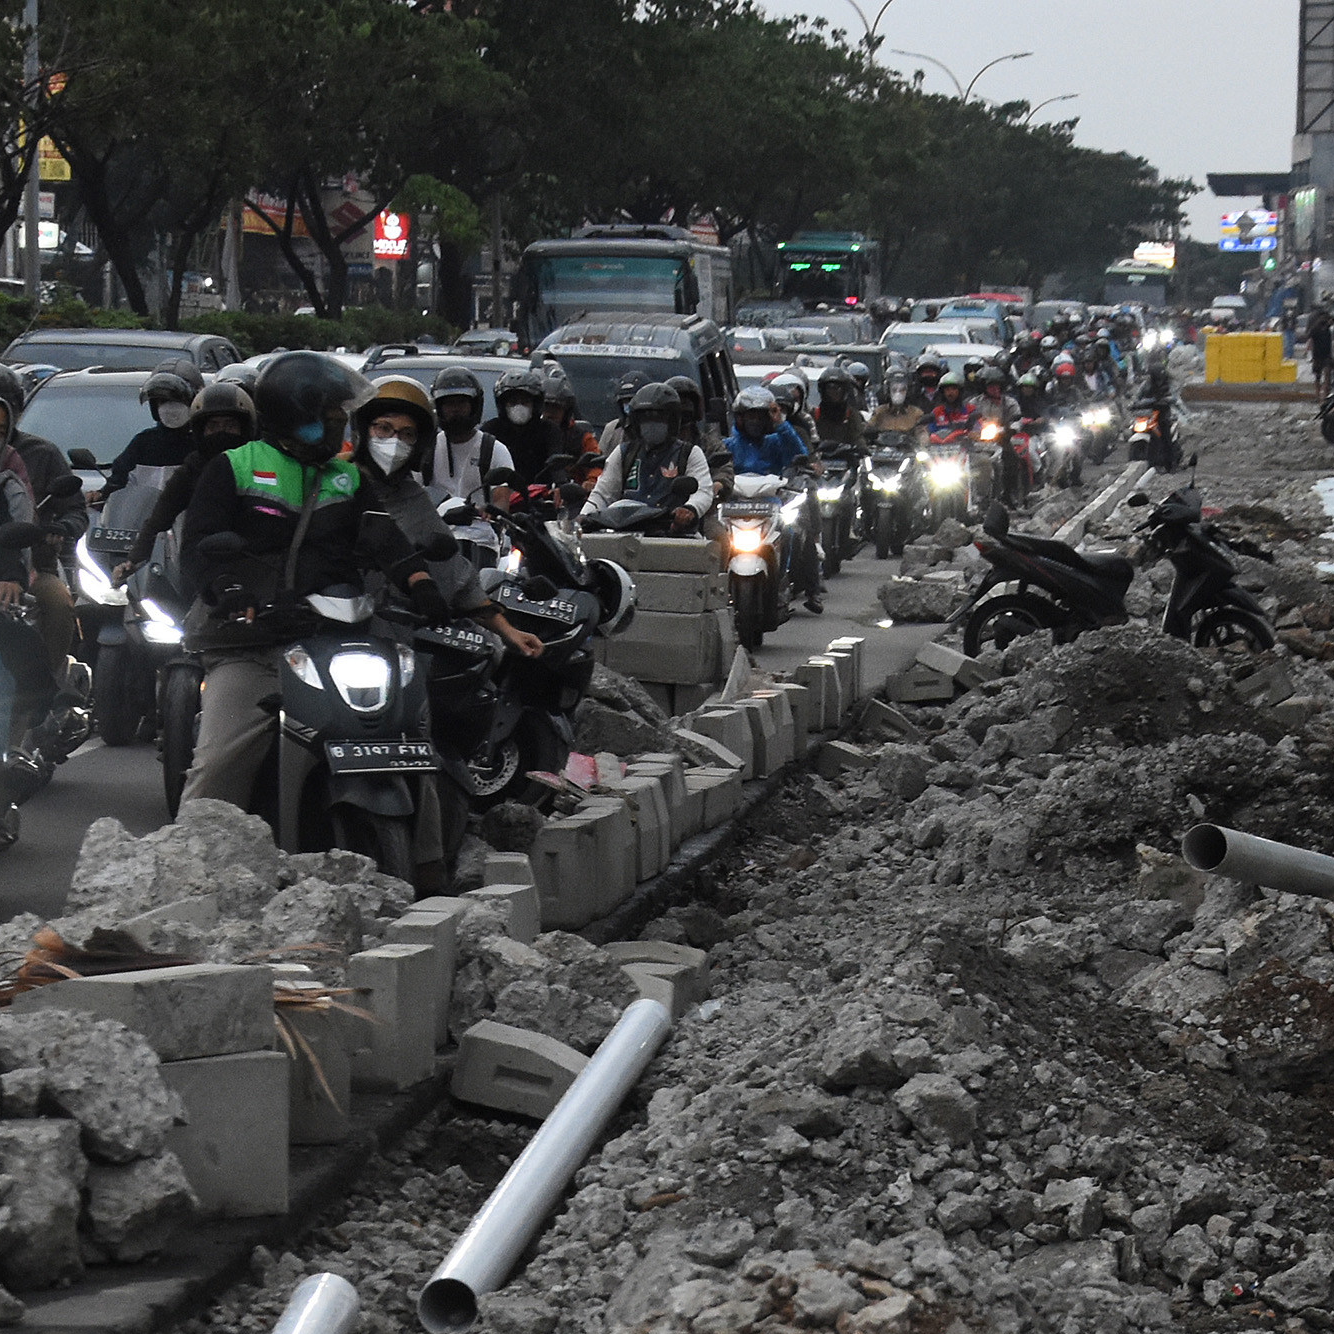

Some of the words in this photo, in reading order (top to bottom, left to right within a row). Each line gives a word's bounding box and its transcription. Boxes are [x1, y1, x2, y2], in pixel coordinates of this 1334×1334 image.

[94, 529, 102, 539] B
[503, 588, 511, 597] B
[332, 746, 345, 758] B
[398, 745, 428, 756] FTK
